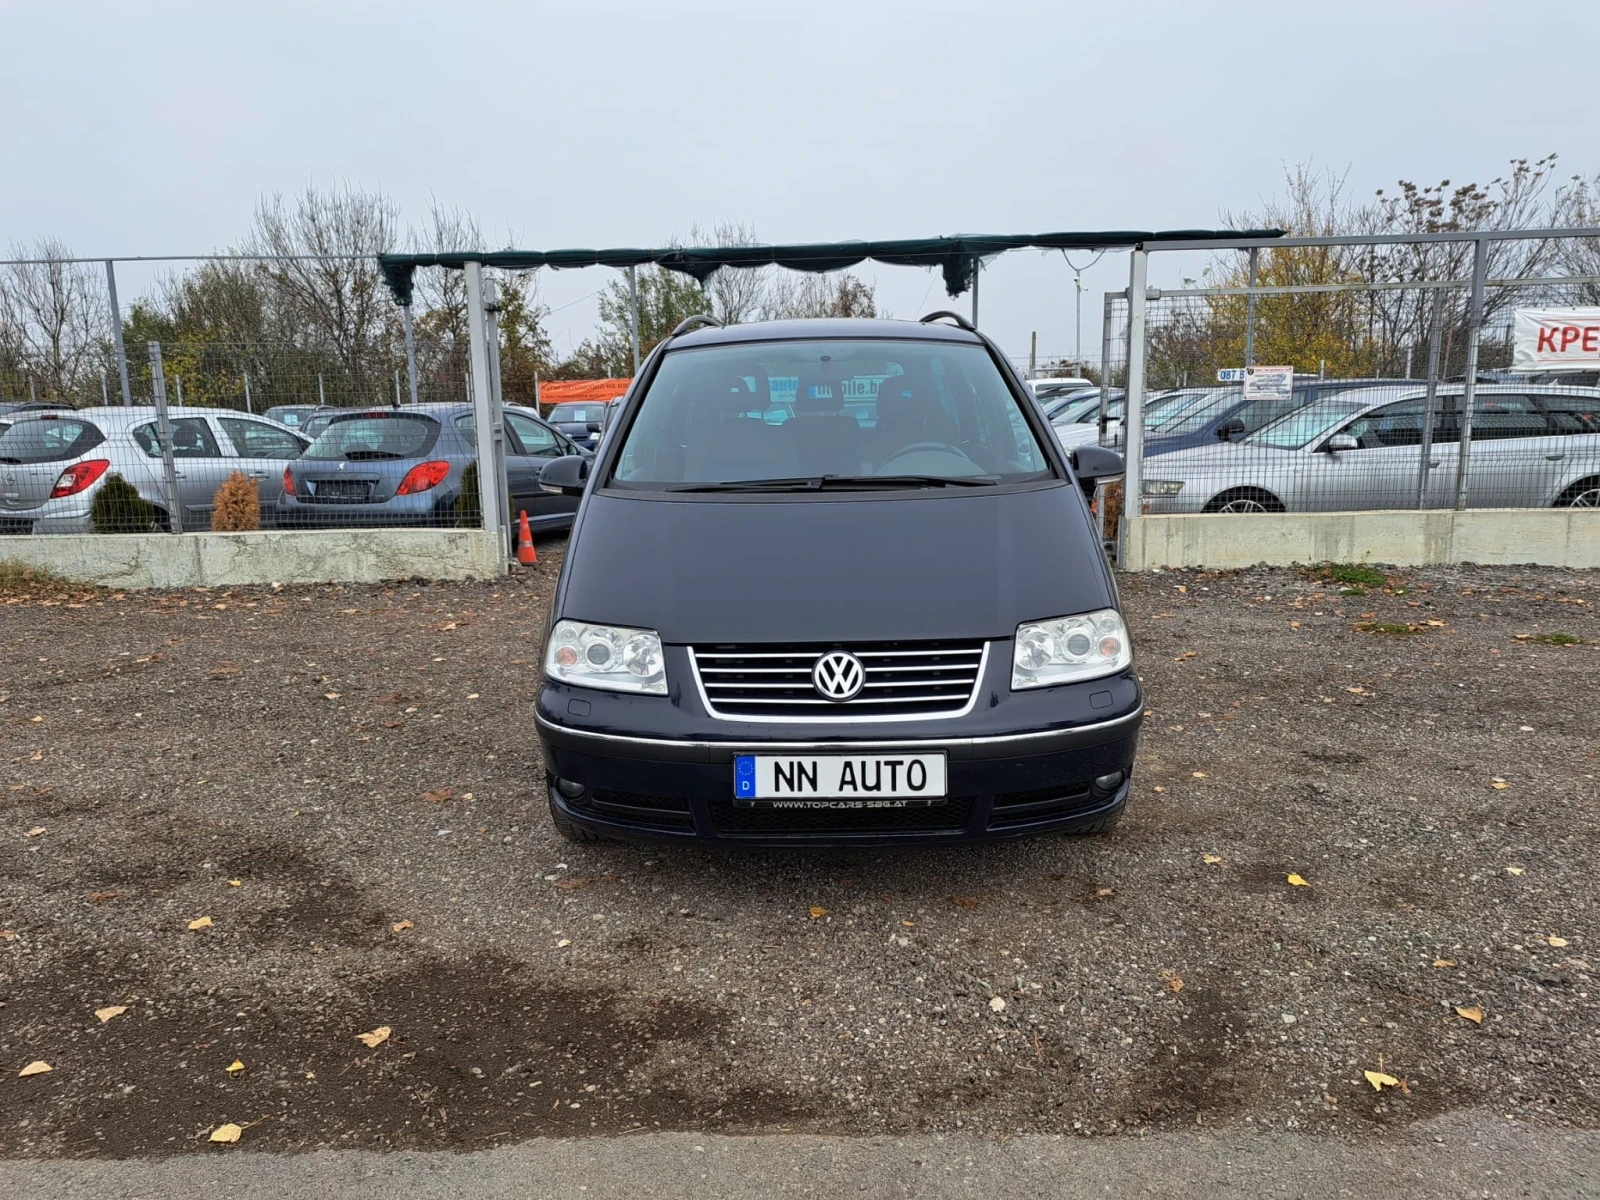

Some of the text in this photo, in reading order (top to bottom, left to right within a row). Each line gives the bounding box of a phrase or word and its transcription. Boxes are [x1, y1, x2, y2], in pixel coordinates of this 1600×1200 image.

[1537, 326, 1600, 352] КРЕ
[1220, 370, 1236, 380] 087
[741, 759, 927, 792] D NN AUTO
